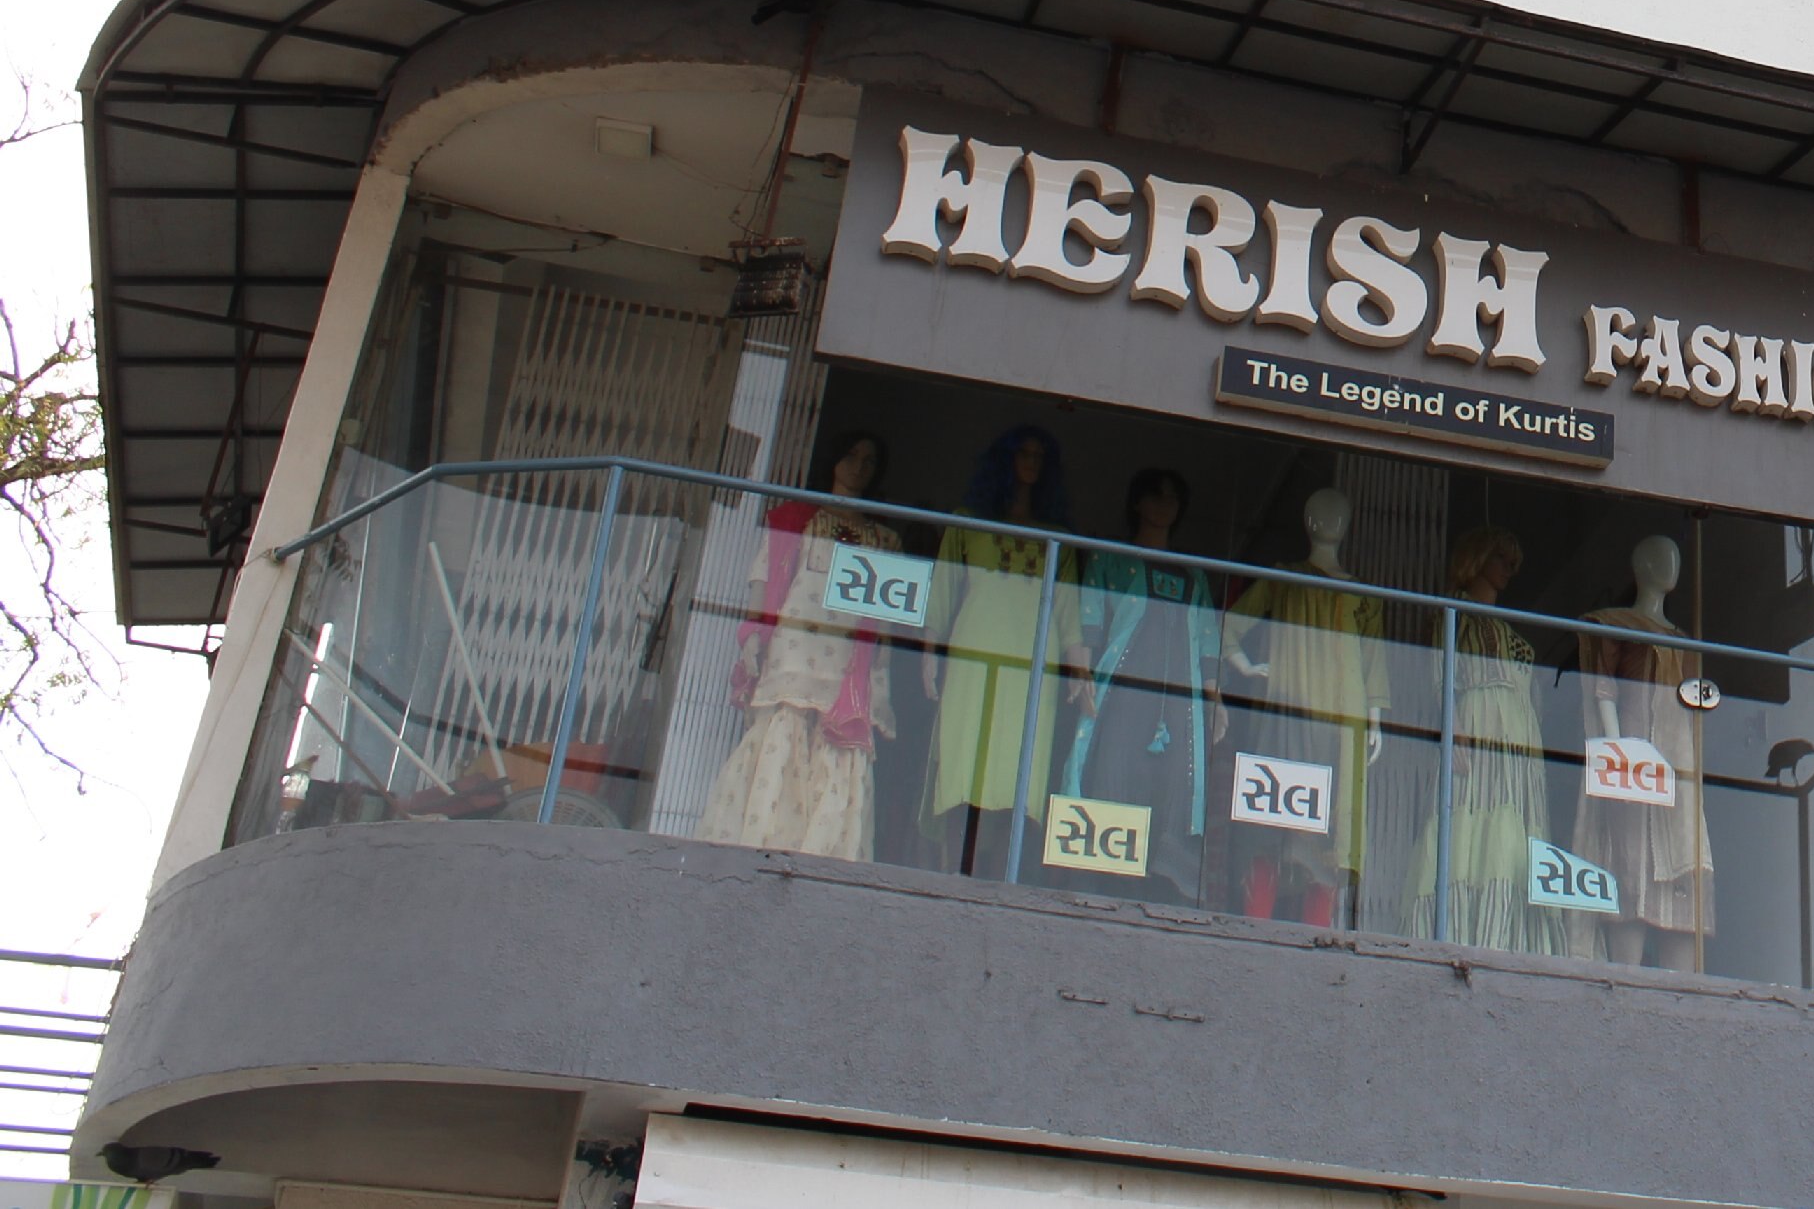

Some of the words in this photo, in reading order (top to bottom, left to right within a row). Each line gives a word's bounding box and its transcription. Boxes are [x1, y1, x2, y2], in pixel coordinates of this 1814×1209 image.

[880, 123, 1552, 375] HERISH
[1246, 358, 1309, 394] The
[1319, 370, 1444, 417] Legend
[1454, 399, 1489, 424] of
[1498, 402, 1596, 442] Kurtis
[836, 554, 917, 613] સેલ
[1242, 764, 1322, 821] સેલ
[1595, 741, 1669, 795] સેલ
[1056, 803, 1139, 862] સેલ
[1536, 846, 1613, 902] સેલ
